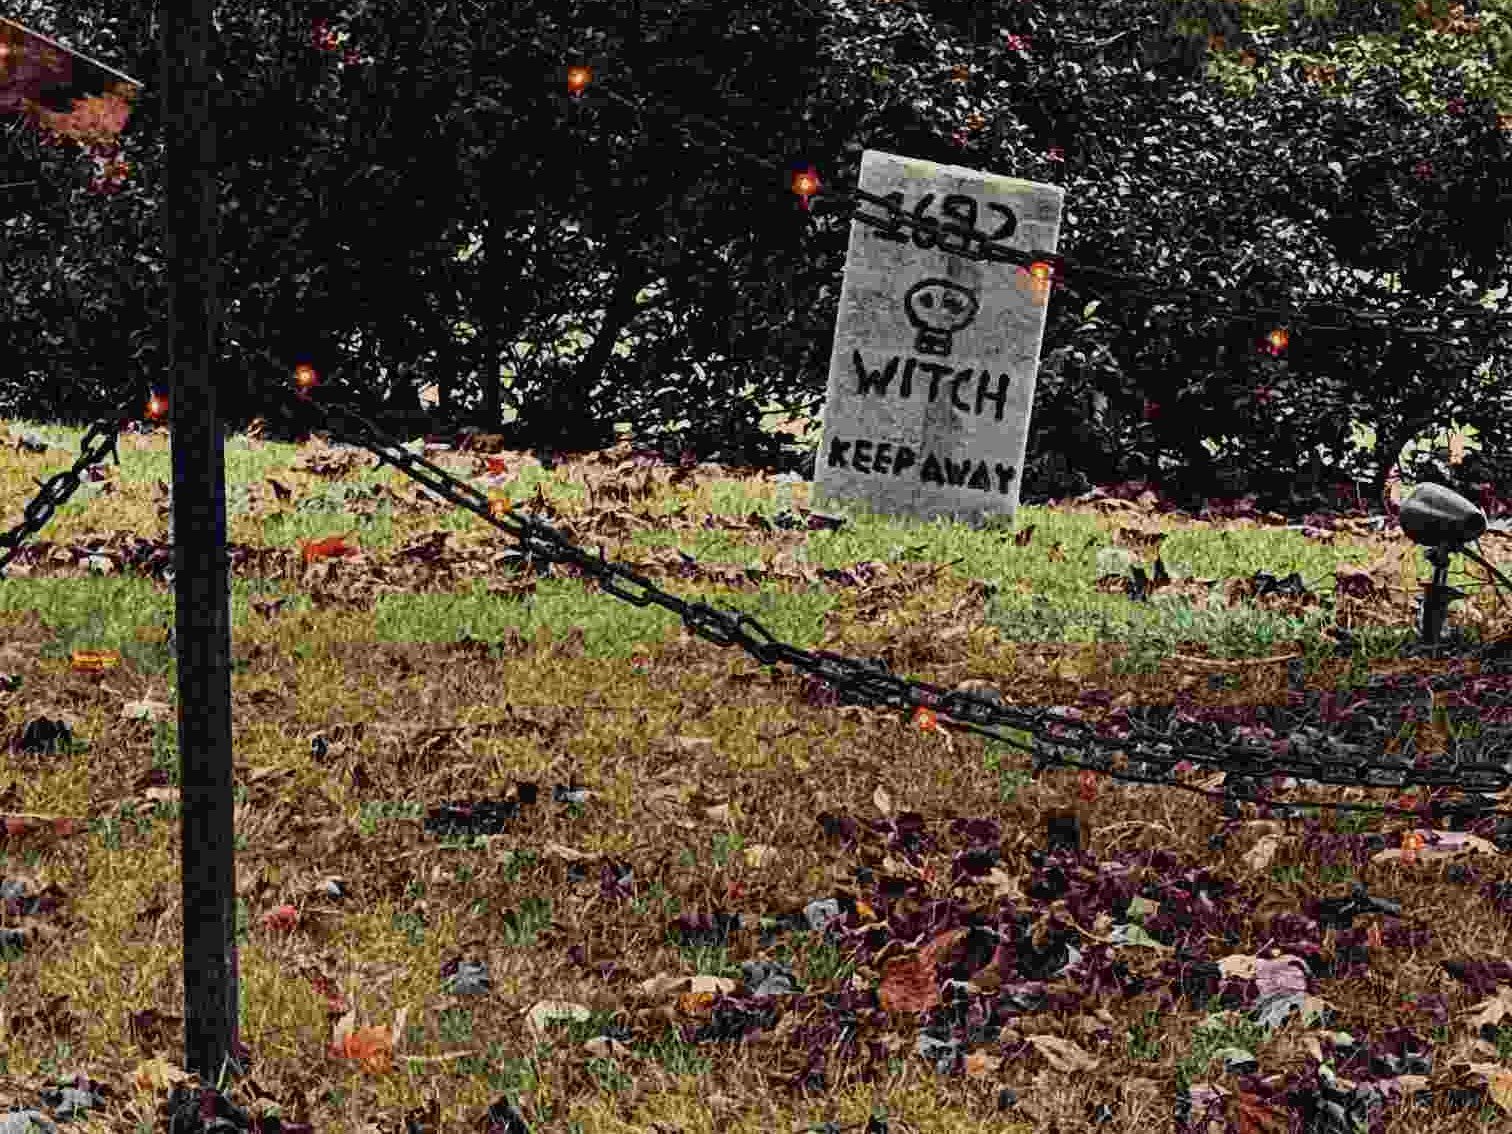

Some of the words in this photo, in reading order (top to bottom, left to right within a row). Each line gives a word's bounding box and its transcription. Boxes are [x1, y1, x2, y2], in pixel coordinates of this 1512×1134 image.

[852, 349, 1011, 420] WITCH
[828, 436, 915, 476] KEEP
[920, 452, 1017, 495] AWAY
